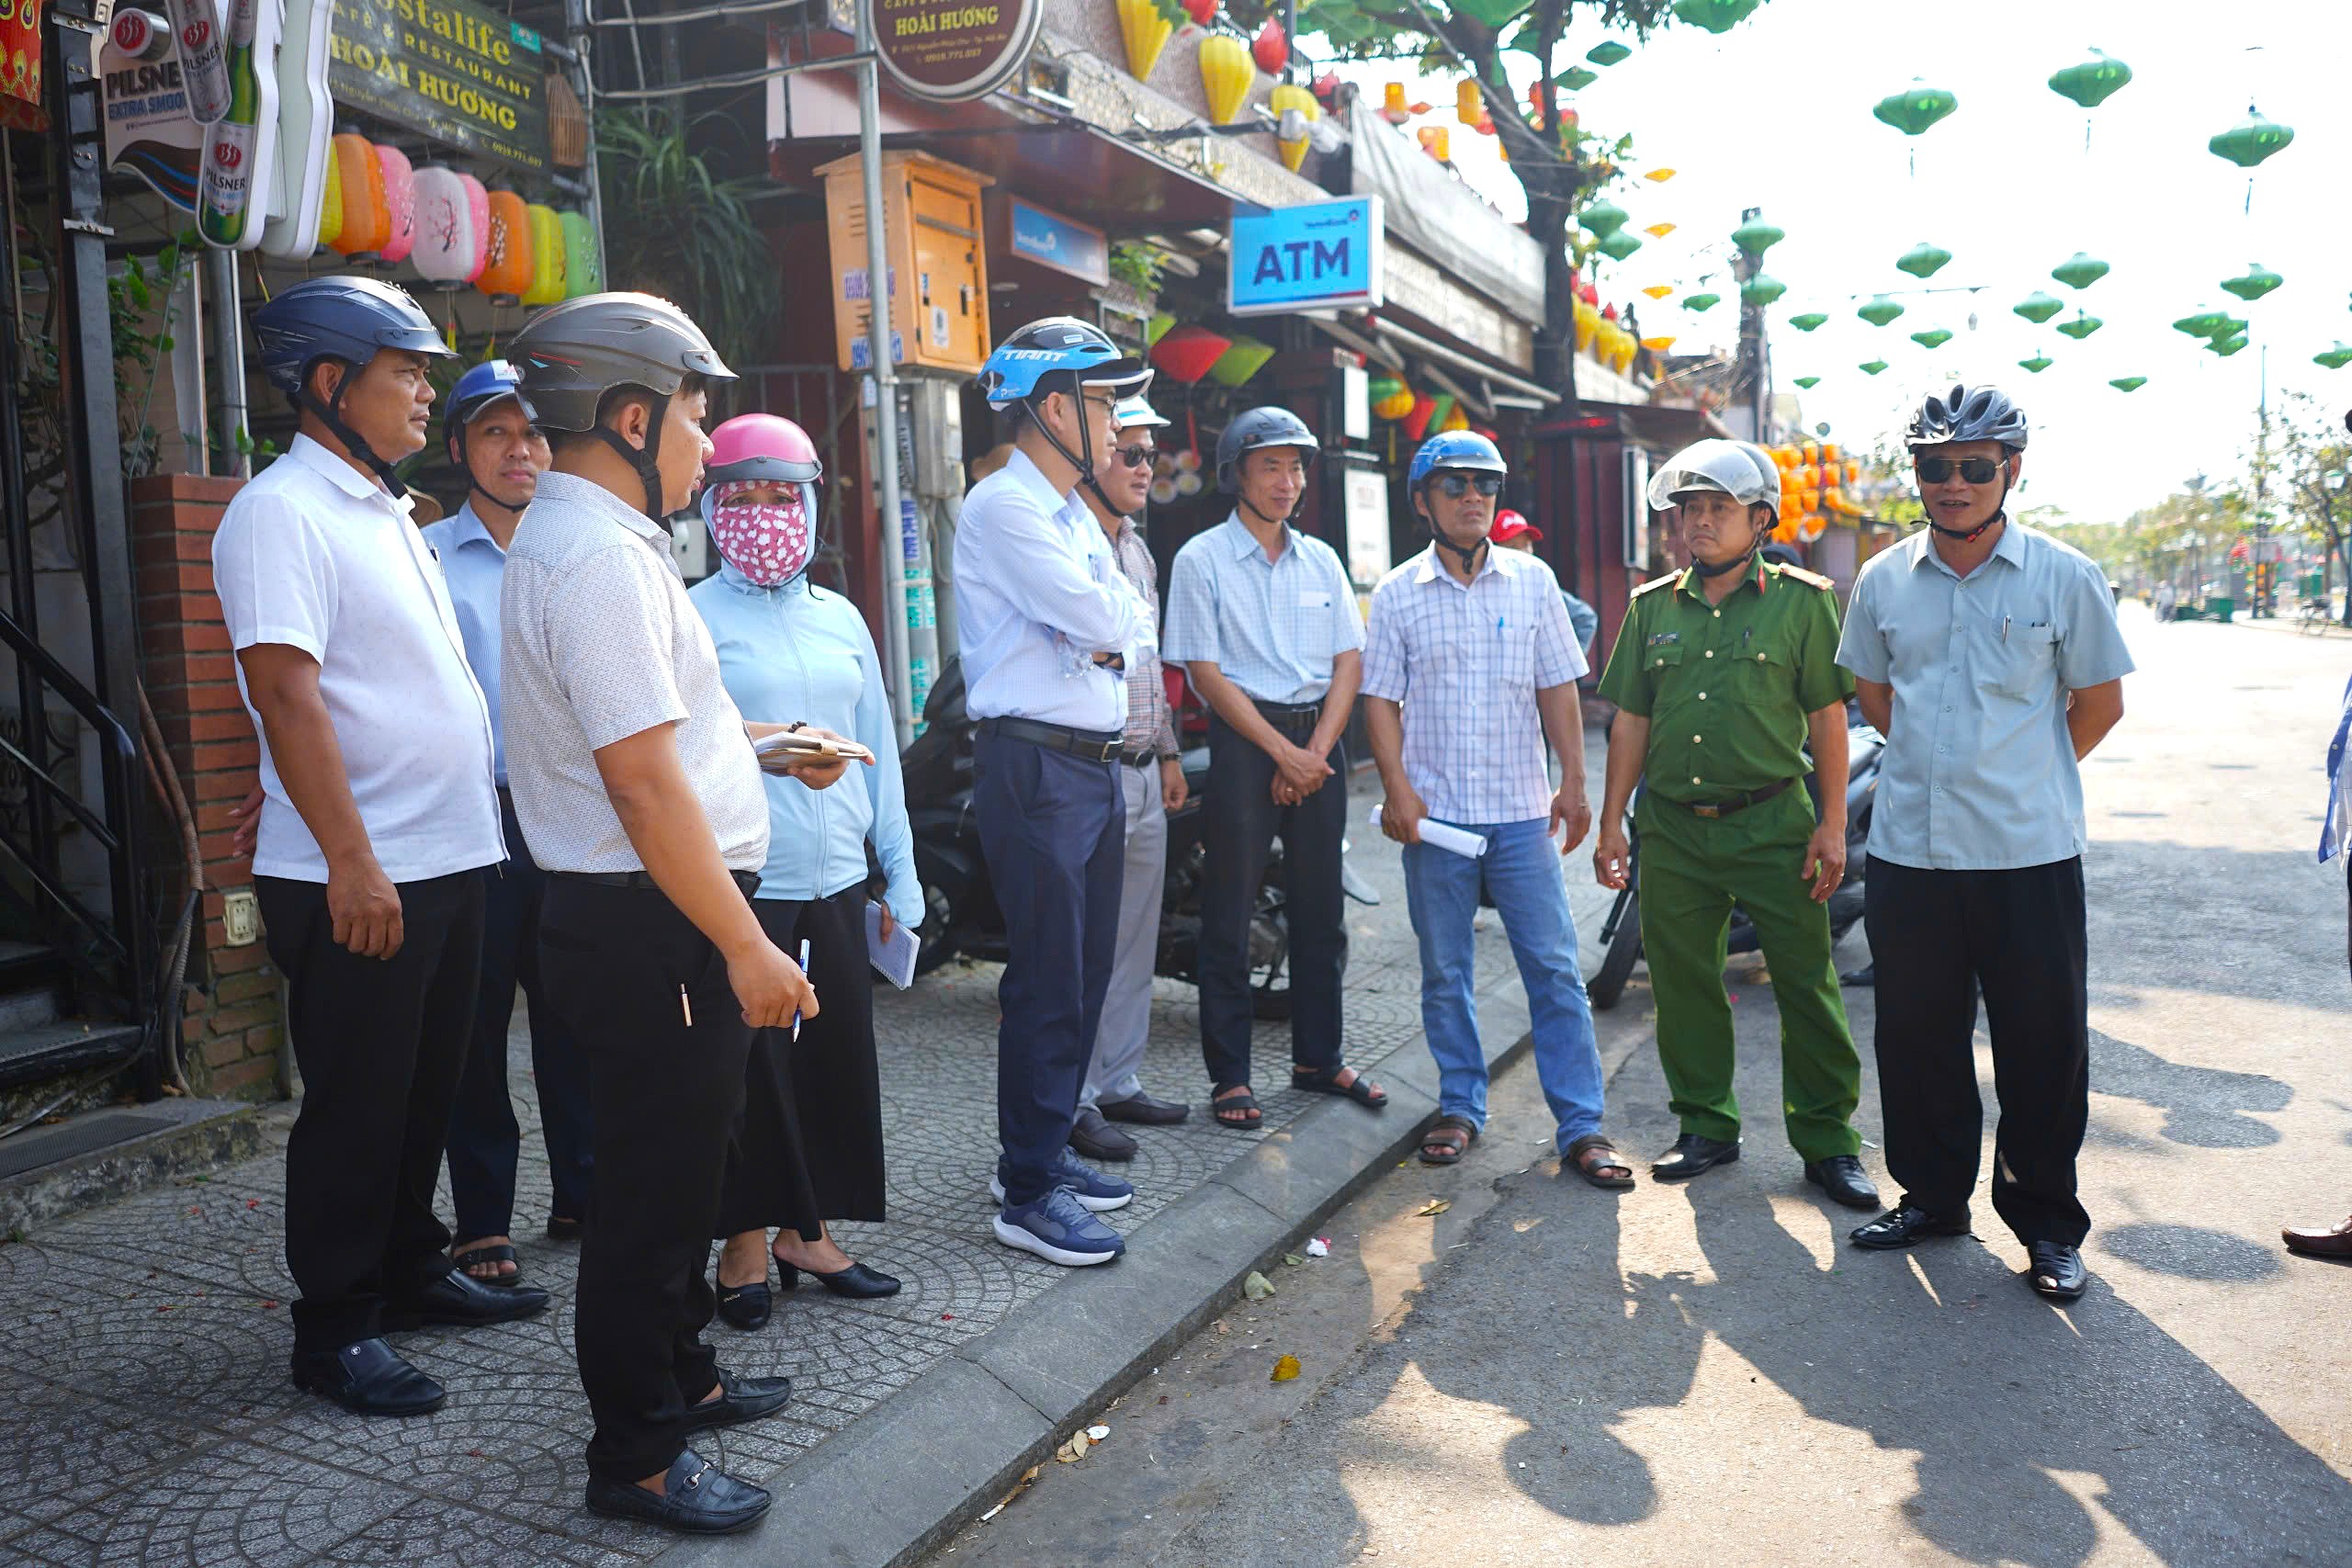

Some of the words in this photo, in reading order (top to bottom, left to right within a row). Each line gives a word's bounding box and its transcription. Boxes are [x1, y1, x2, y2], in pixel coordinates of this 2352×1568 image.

[895, 10, 936, 36] HOÀI
[940, 5, 1000, 30] HƯƠNG
[106, 61, 184, 99] PILSNE
[331, 32, 412, 89] HOÀI
[418, 69, 517, 130] HƯƠNG
[404, 32, 531, 100] RESTAURANT
[107, 98, 147, 120] EXTRA
[148, 92, 187, 114] SMOO
[206, 164, 245, 191] PILSNER
[1253, 236, 1349, 286] ATM
